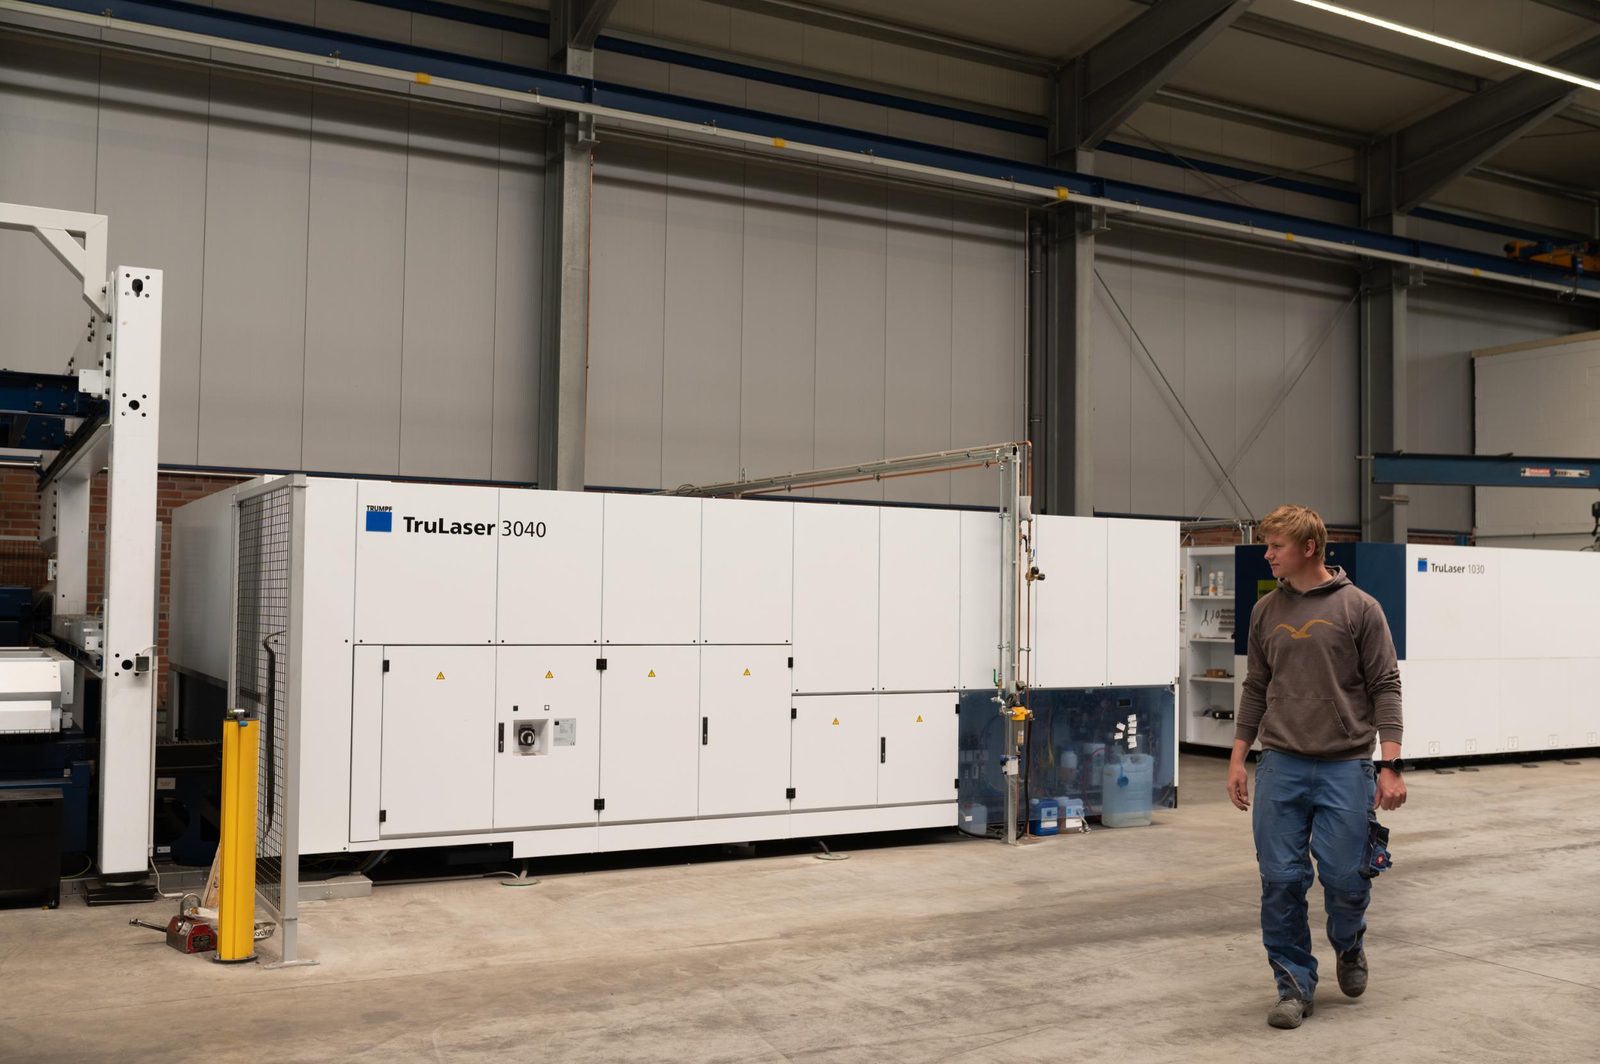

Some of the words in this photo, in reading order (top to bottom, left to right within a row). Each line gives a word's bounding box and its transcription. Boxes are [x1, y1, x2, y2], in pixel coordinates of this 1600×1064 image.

[403, 516, 496, 536] TruLaser
[501, 520, 547, 538] 3040
[1431, 563, 1466, 573] TruLaser
[1468, 564, 1485, 574] 1030
